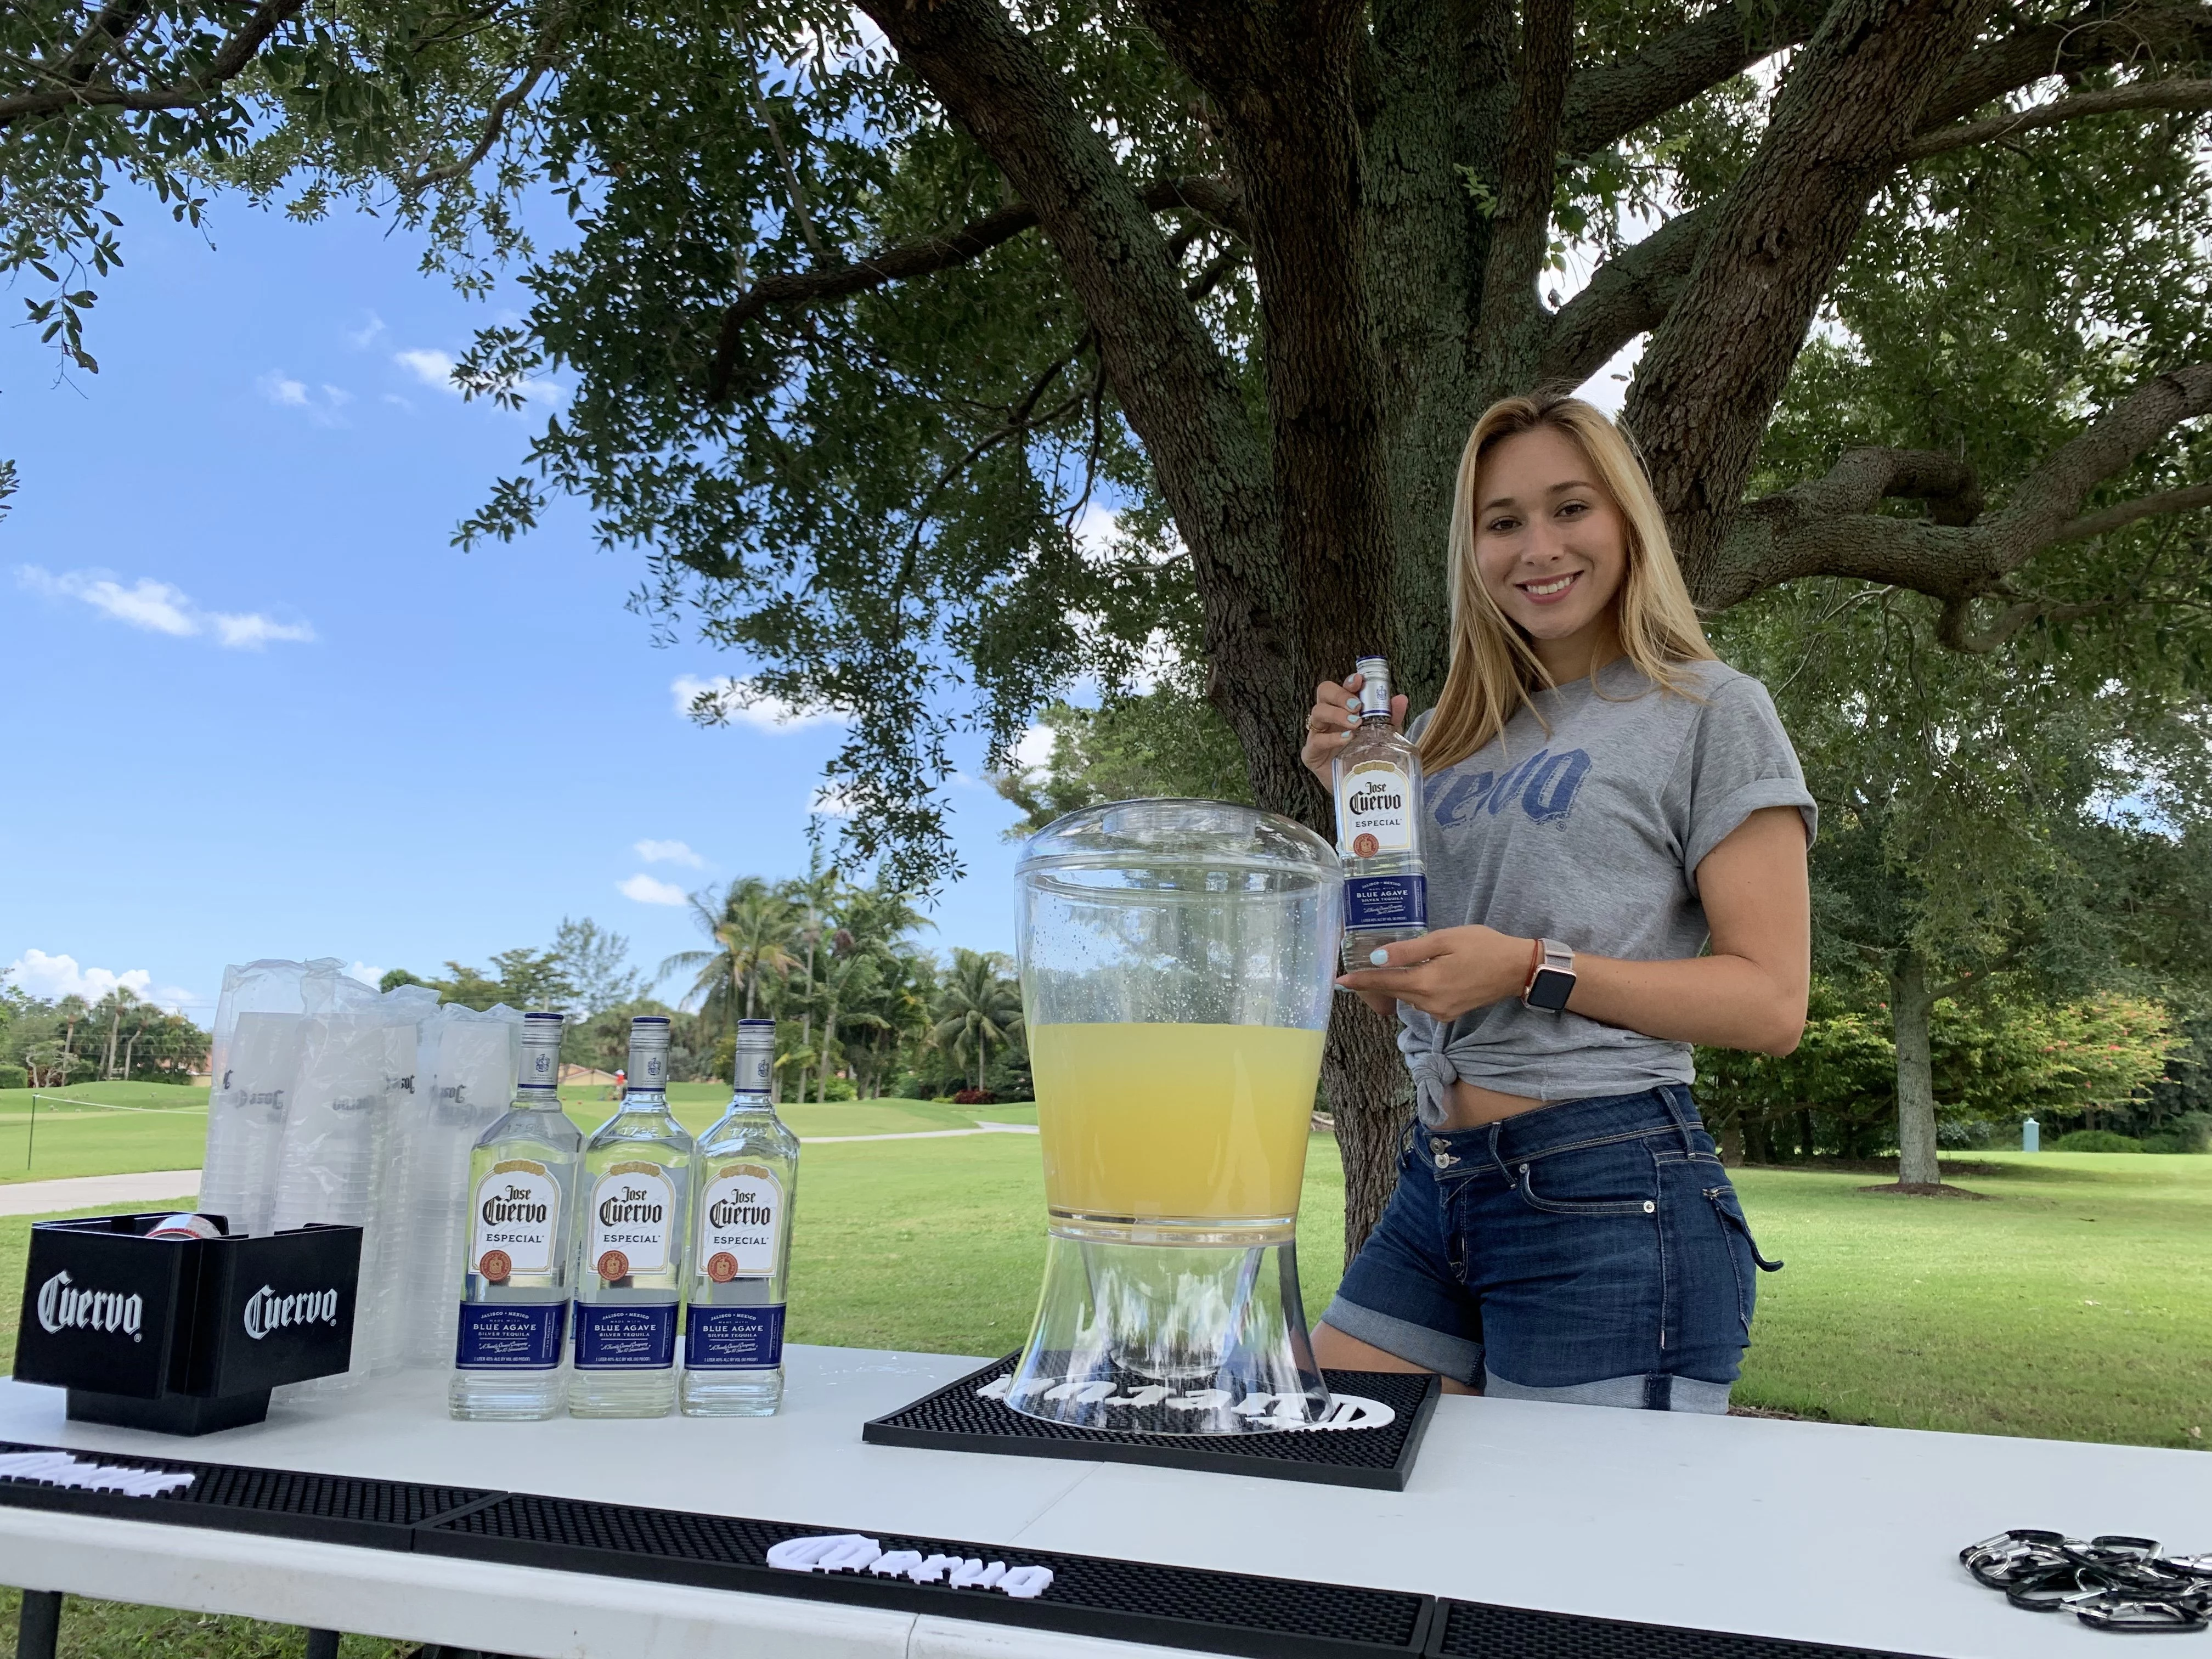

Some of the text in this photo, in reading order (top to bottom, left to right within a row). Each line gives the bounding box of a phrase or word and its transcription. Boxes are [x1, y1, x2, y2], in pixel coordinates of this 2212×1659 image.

[1365, 781, 1387, 795] Jose
[1350, 790, 1401, 815] Cuervo
[1355, 819, 1400, 827] ESPECIAL
[505, 1185, 532, 1203] Jose
[622, 1186, 647, 1203] Jose
[731, 1188, 756, 1205] Jose
[483, 1195, 546, 1226] Cuervo
[599, 1196, 662, 1227] Cuervo
[709, 1198, 770, 1229] Cuervo
[486, 1234, 541, 1243] ESPECIAL
[603, 1234, 658, 1243] ESPECIAL
[37, 1269, 143, 1335] Cuervo
[244, 1284, 338, 1340] Cuervo
